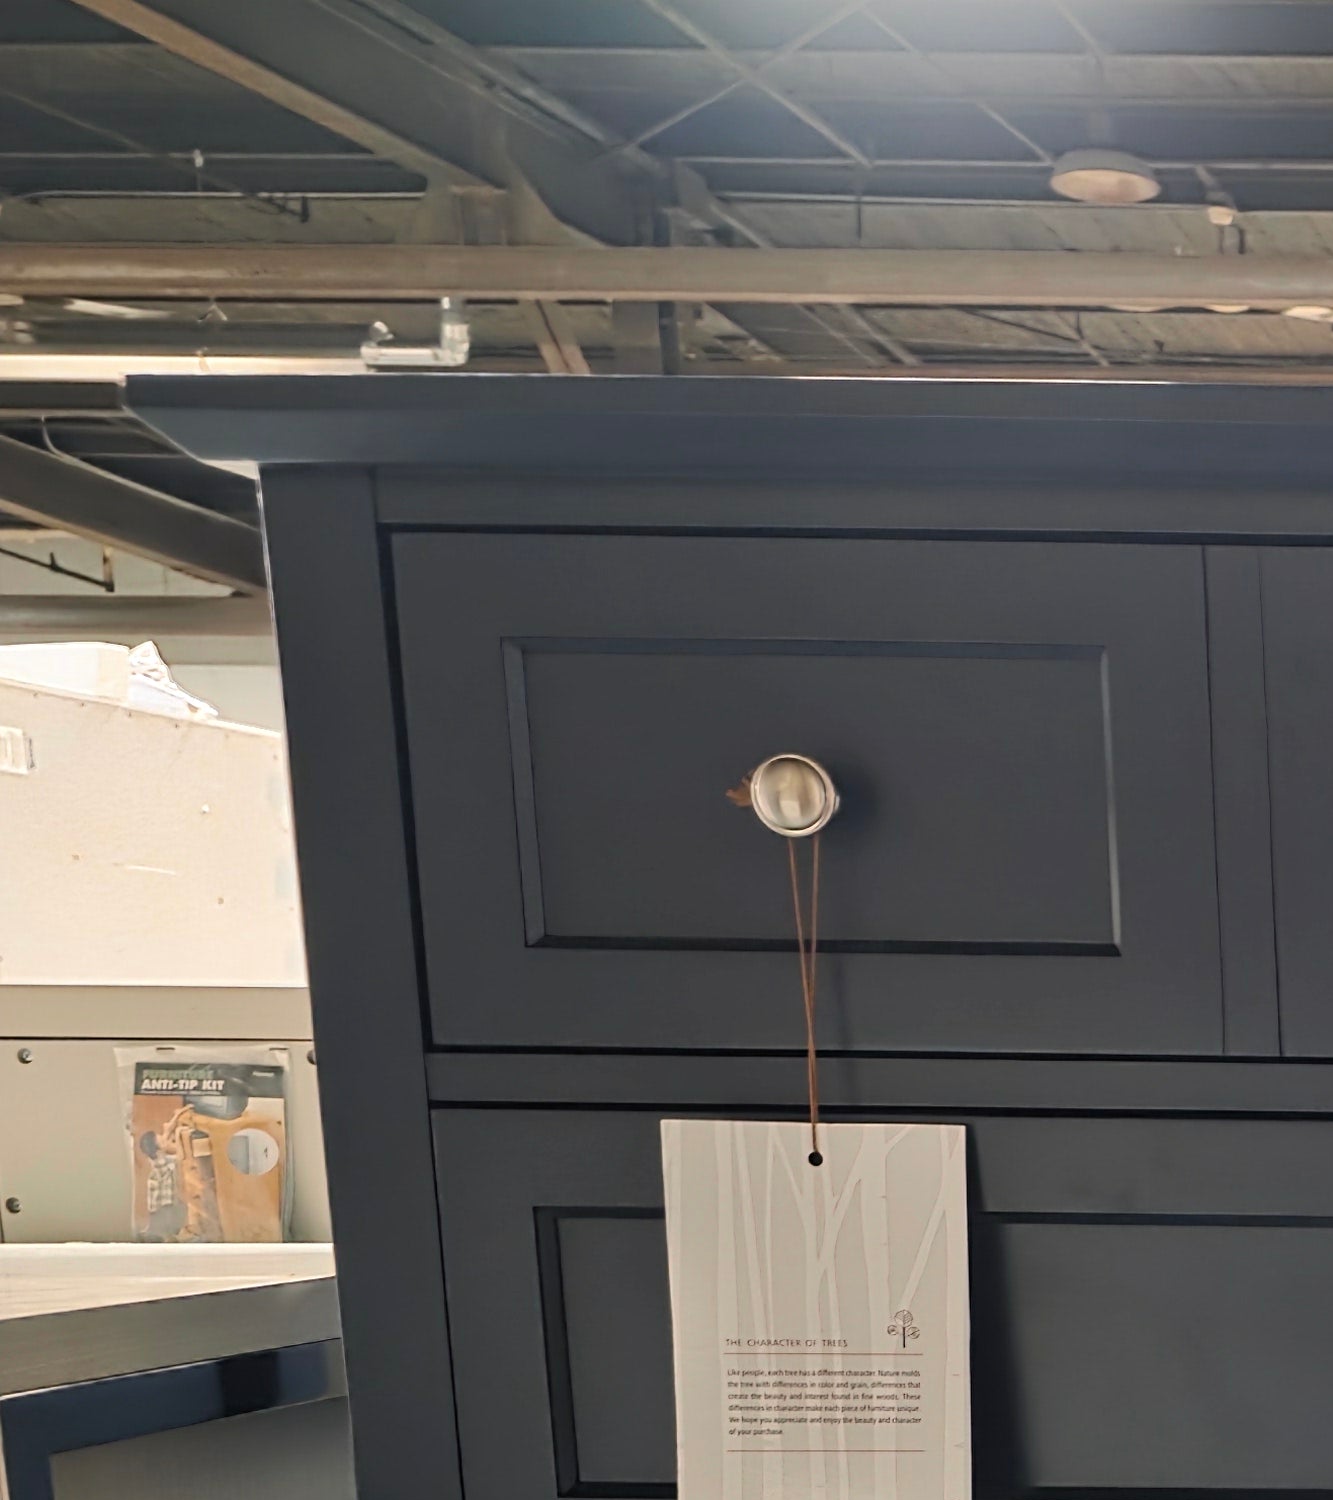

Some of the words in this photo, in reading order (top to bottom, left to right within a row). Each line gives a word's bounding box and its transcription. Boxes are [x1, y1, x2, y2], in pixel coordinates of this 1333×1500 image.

[141, 1079, 198, 1090] ANTI-TIP
[202, 1080, 225, 1091] KIT
[726, 1339, 741, 1347] THE
[747, 1339, 801, 1347] CHARACTER
